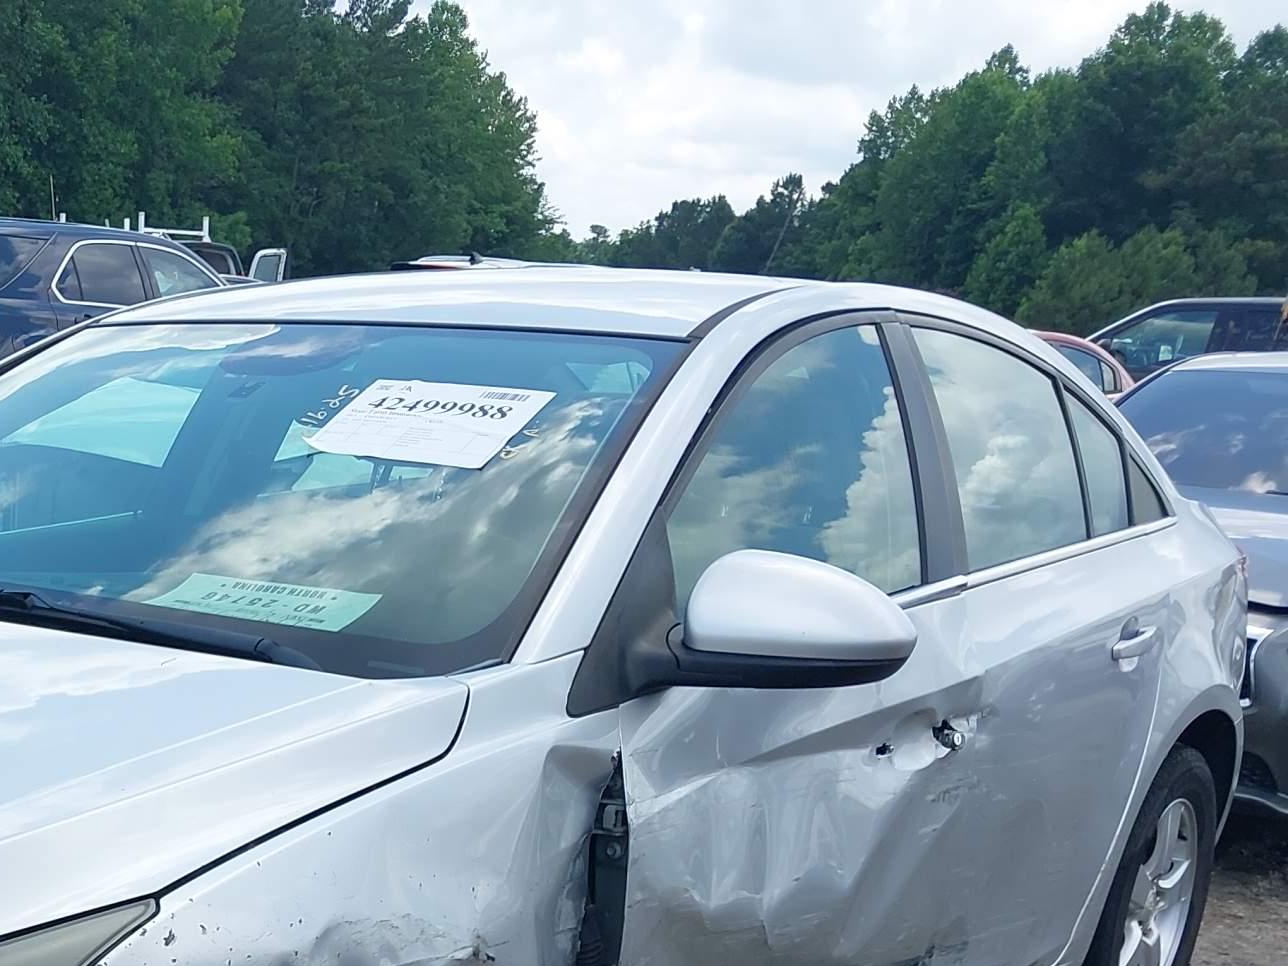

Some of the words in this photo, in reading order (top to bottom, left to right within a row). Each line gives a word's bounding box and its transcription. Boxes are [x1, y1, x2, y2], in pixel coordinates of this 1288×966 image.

[368, 396, 514, 420] 42499988
[231, 580, 288, 595] CAROLINA
[287, 588, 328, 601] NORTH
